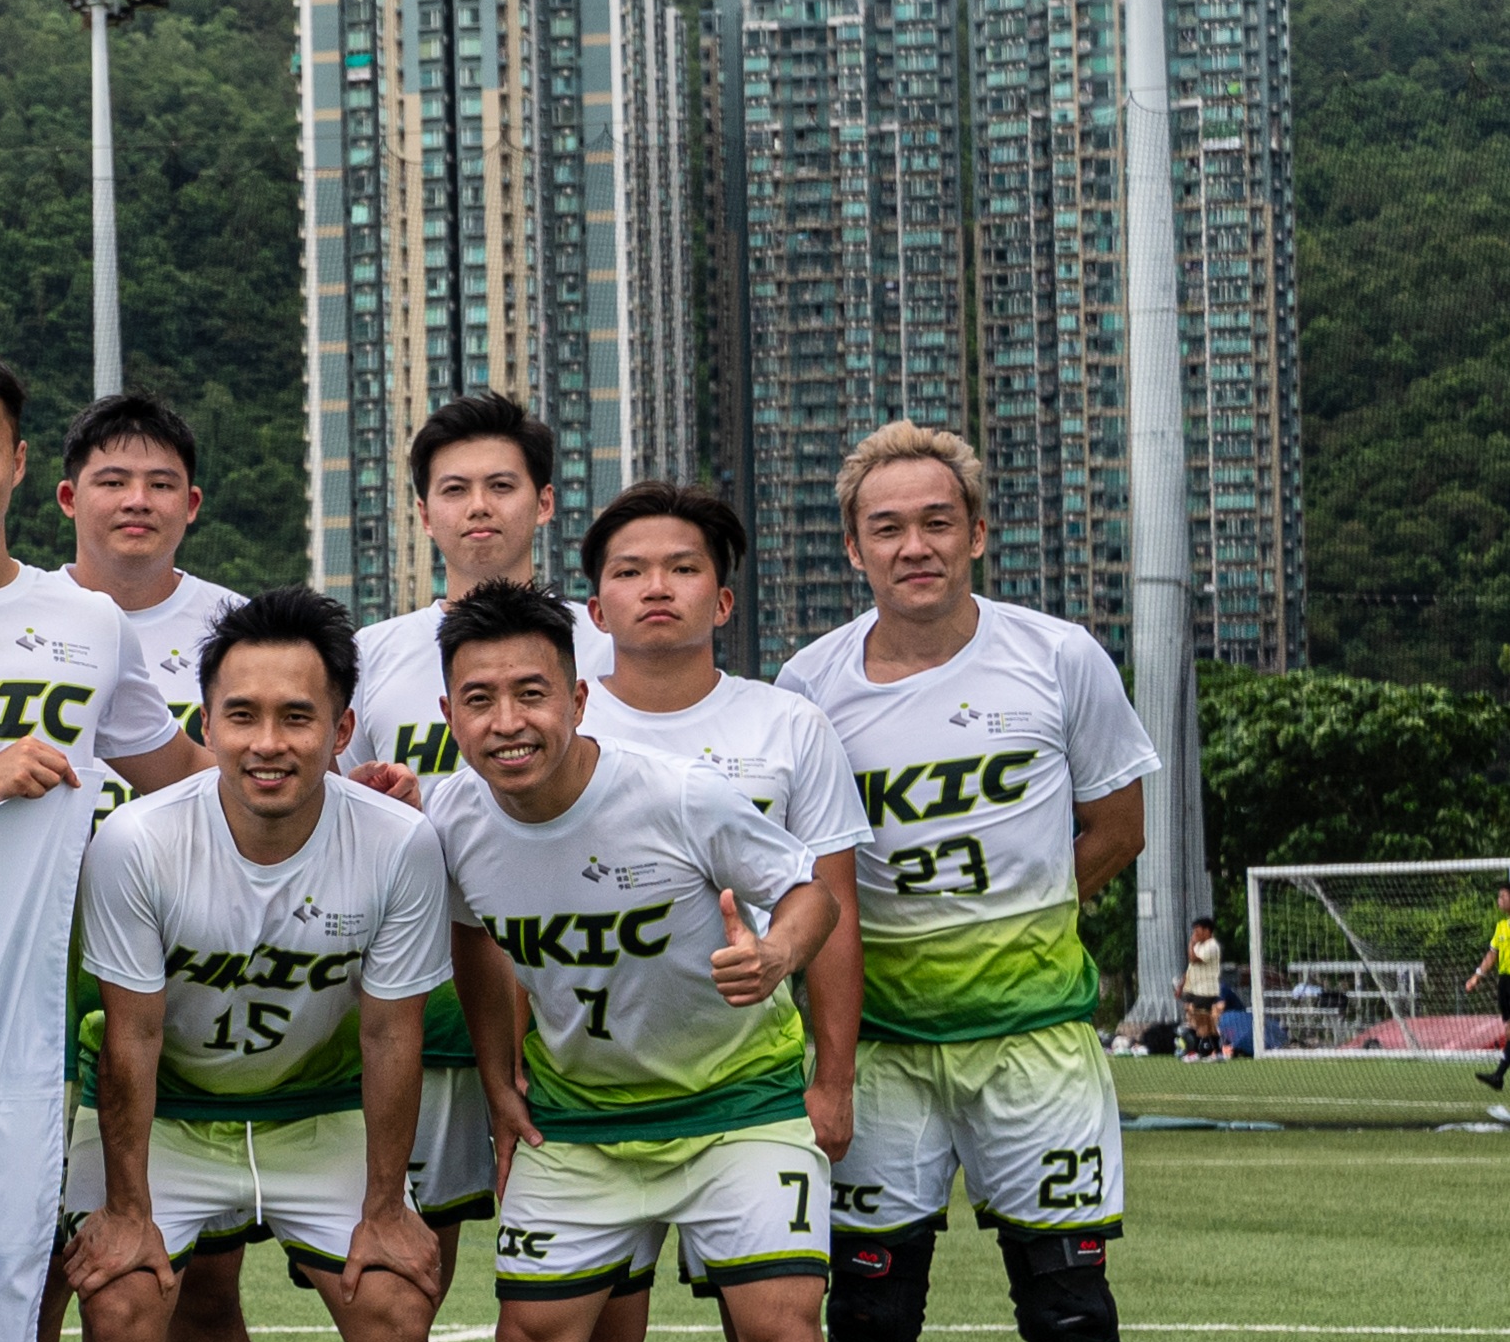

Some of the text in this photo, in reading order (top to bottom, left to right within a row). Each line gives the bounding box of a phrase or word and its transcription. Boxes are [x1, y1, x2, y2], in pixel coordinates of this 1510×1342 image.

[888, 836, 989, 895] 23
[481, 899, 675, 968] HKIC
[203, 1001, 292, 1055] 15
[573, 988, 612, 1041] 7
[778, 1172, 812, 1233] 7
[1038, 1145, 1104, 1209] 23
